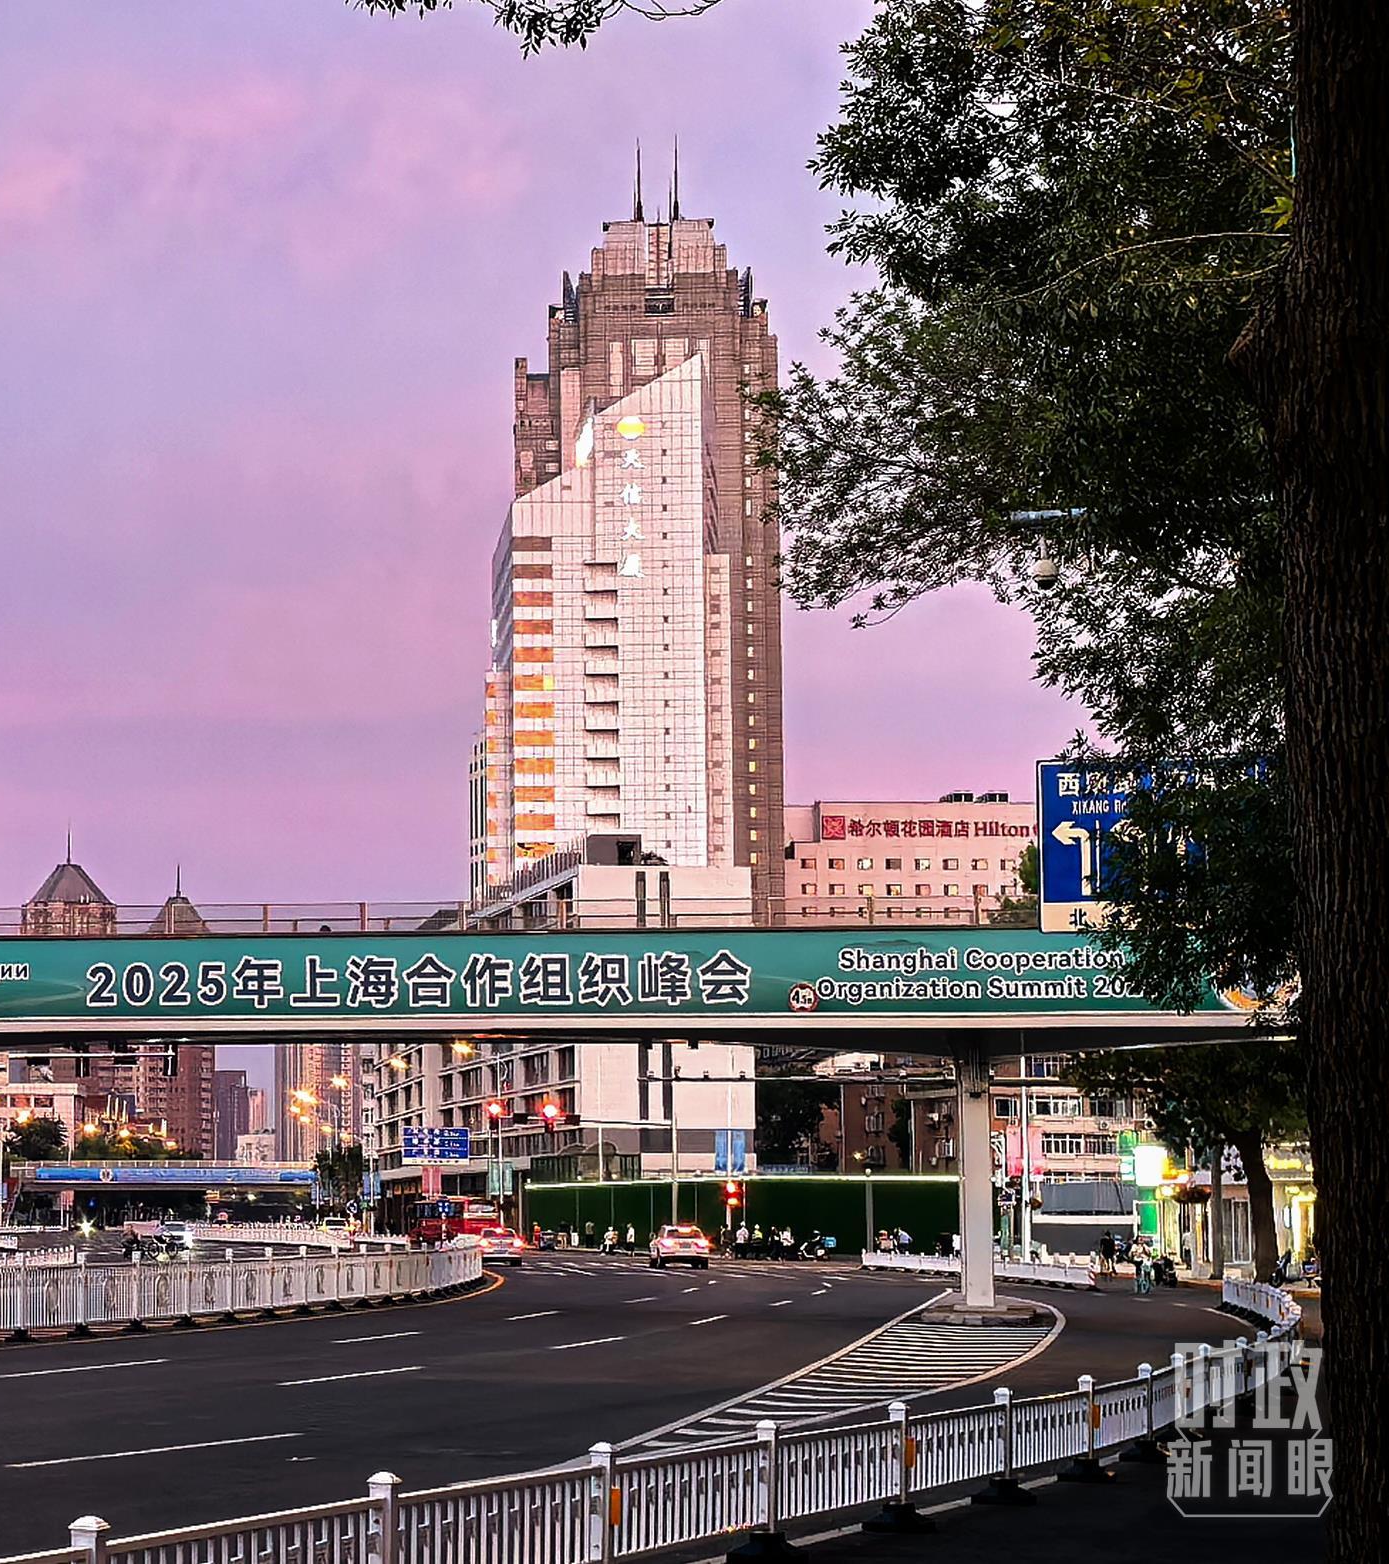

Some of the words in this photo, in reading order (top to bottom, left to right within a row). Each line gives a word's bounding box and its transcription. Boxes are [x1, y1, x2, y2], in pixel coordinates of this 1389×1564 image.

[1072, 799, 1109, 815] XIKANG
[848, 819, 970, 838] 希尔顿花园酒店
[973, 821, 1031, 837] Hilton
[838, 948, 958, 976] Shanghai
[964, 946, 1126, 974] Cooperation
[85, 949, 751, 1009] 2025年上海合作组织峰会
[816, 977, 981, 1005] Organization
[987, 975, 1087, 999] Summit
[1093, 974, 1158, 999] 202
